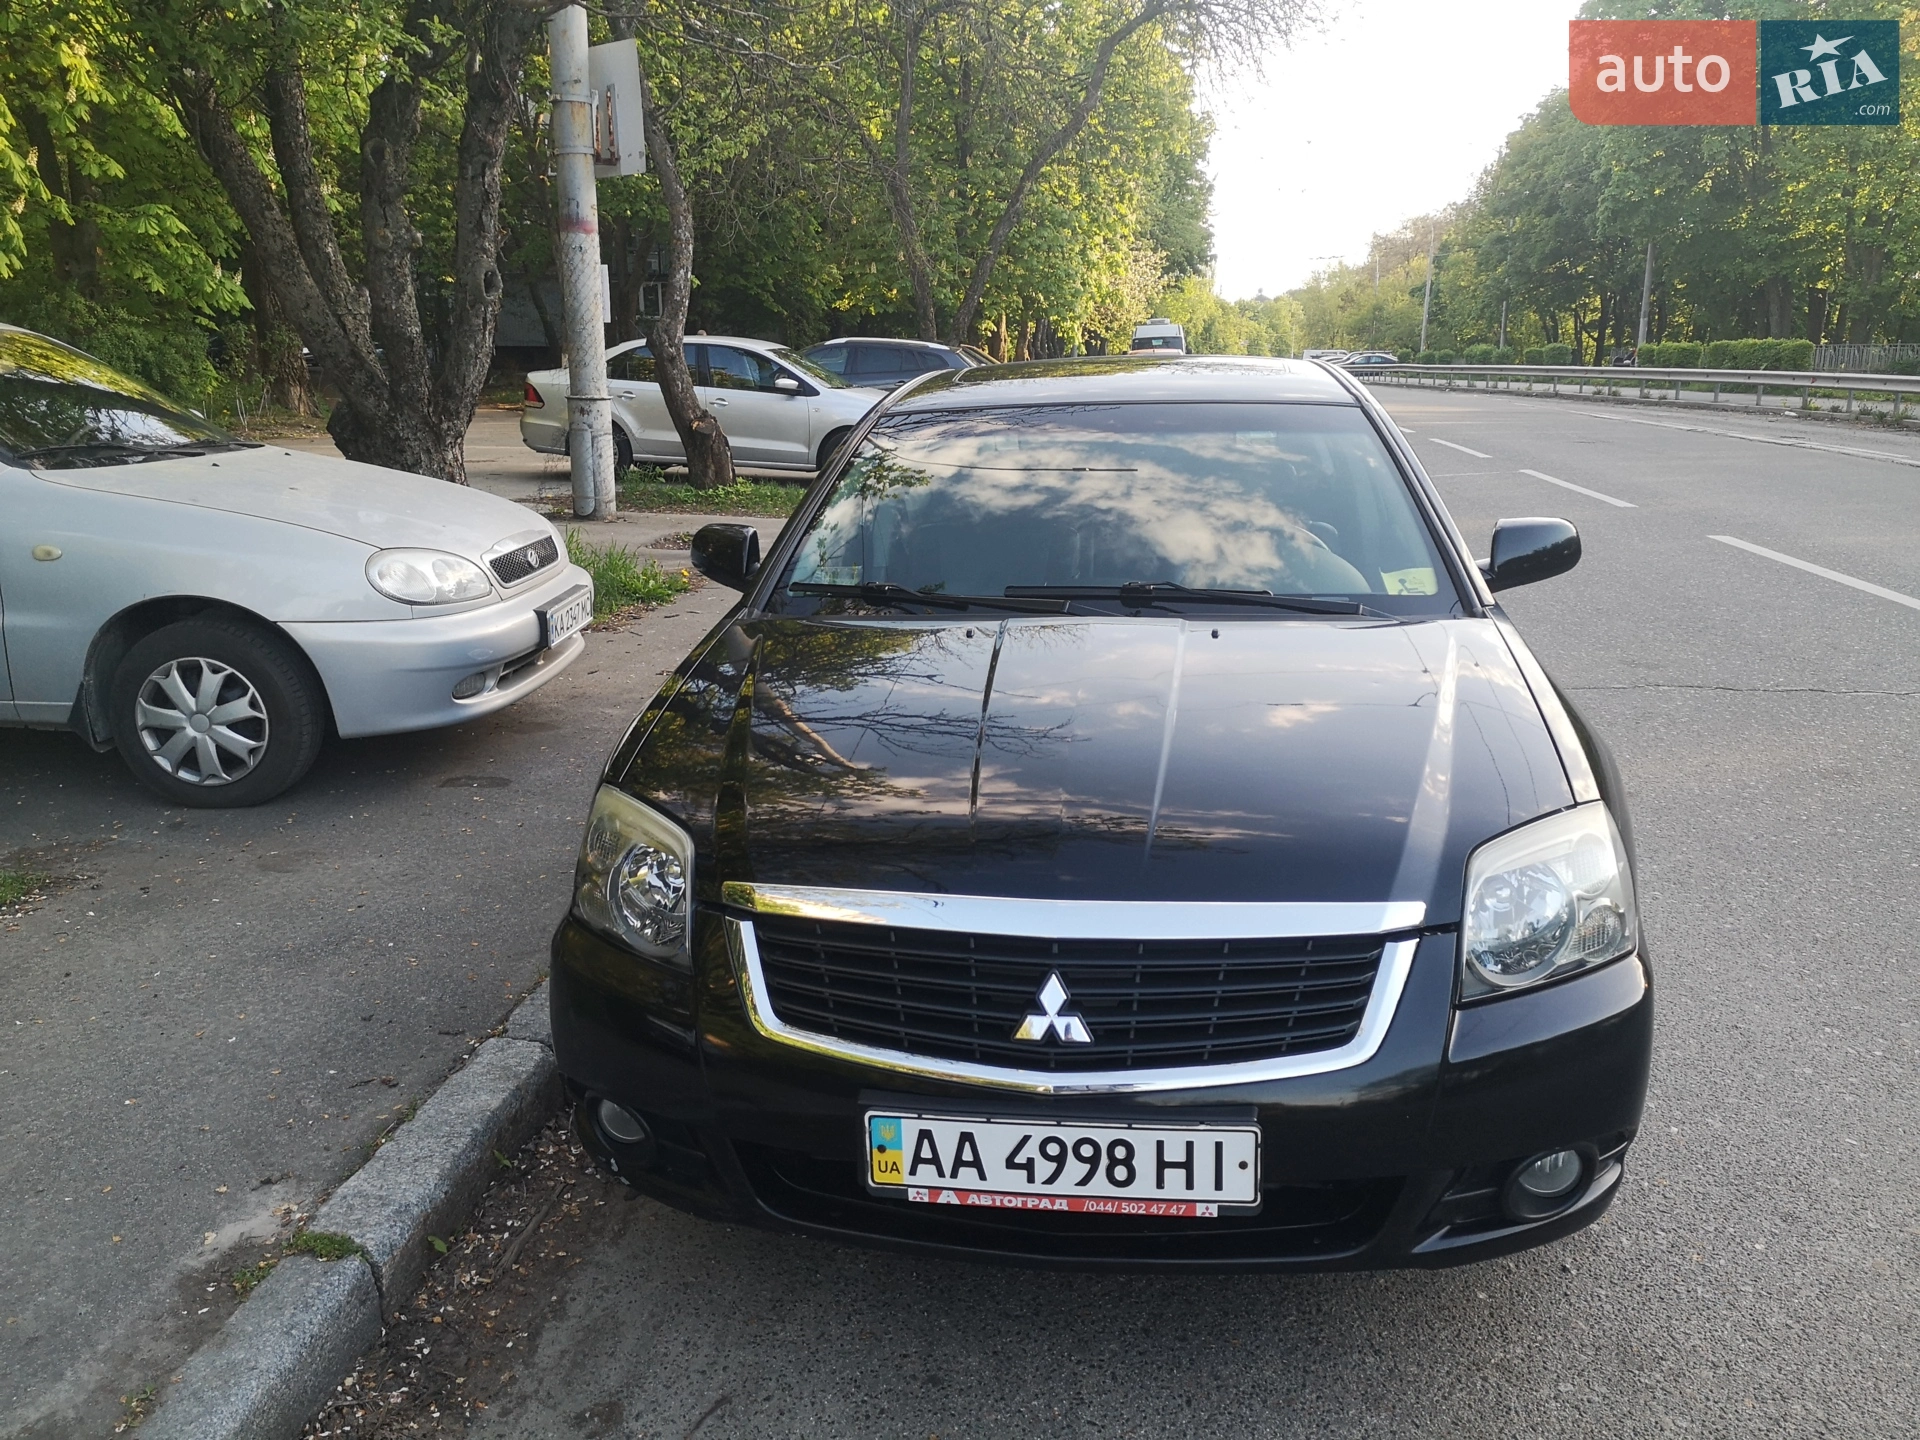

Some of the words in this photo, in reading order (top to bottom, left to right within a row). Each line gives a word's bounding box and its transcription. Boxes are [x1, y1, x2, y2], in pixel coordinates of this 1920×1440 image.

[878, 1160, 901, 1175] UA
[908, 1128, 987, 1181] AA
[1004, 1134, 1137, 1188] 4998
[1156, 1139, 1224, 1191] HI
[966, 1194, 1069, 1211] АВТОГРАД
[1083, 1200, 1118, 1213] /044/
[1121, 1202, 1146, 1214] 502
[1149, 1204, 1167, 1214] 47
[1169, 1204, 1186, 1215] 47
